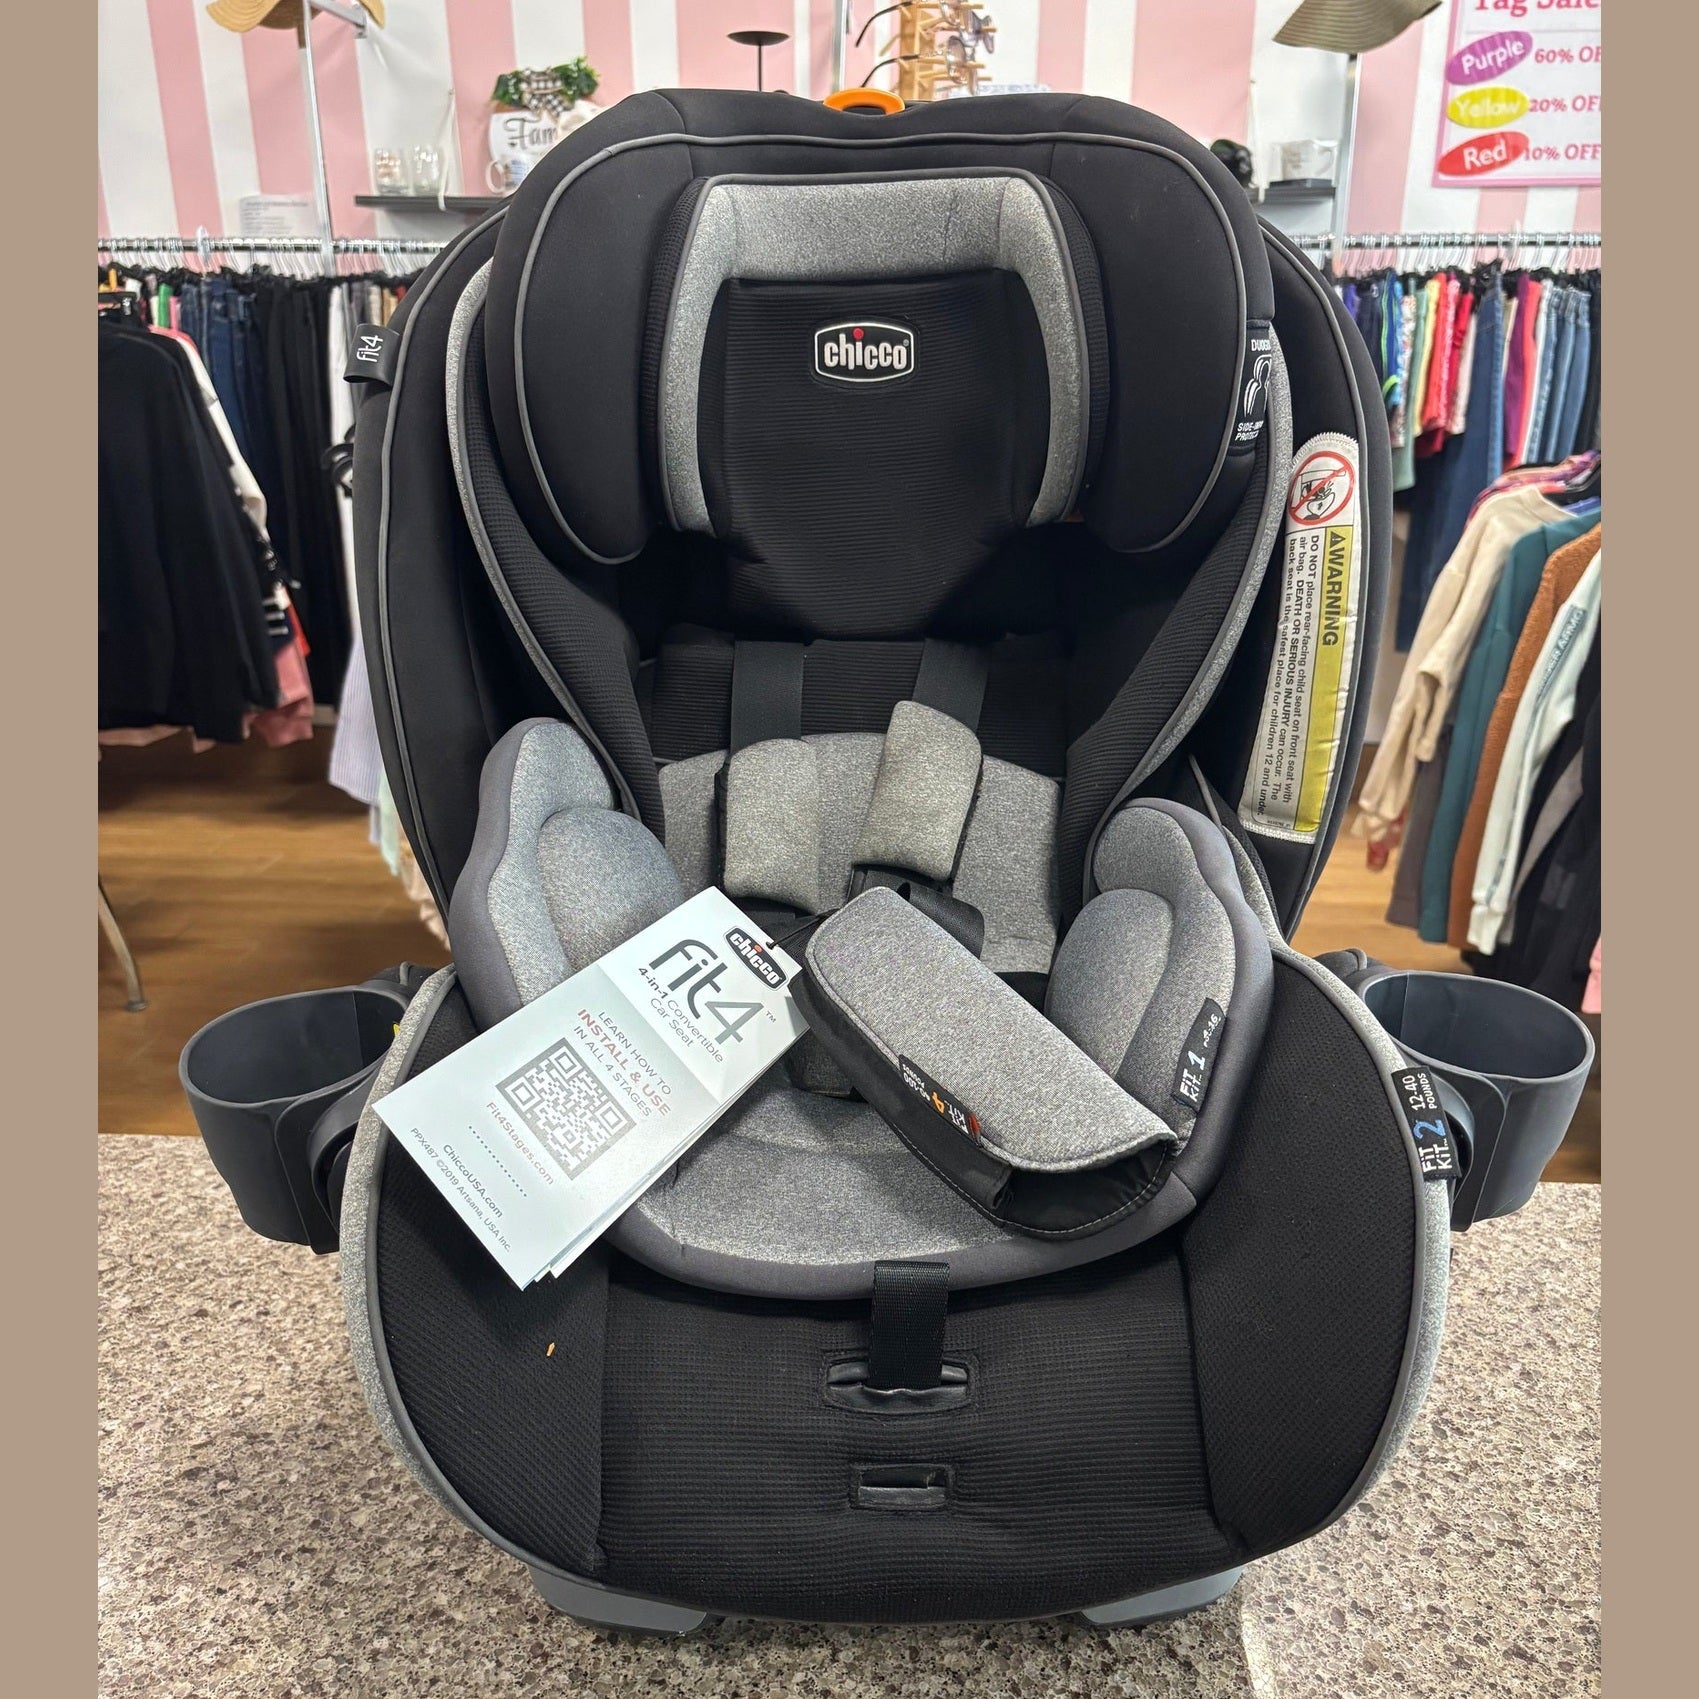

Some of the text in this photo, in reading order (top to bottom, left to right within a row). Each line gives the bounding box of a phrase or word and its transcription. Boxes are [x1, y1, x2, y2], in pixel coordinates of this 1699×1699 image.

[1461, 39, 1525, 75] Purple
[1535, 48, 1574, 64] 60%
[1456, 98, 1521, 118] Yellow
[1529, 95, 1601, 113] 20% OF
[1463, 138, 1507, 170] Red
[1524, 143, 1601, 161] 10% OFF
[356, 335, 384, 363] fit4
[824, 328, 907, 370] chicco
[1289, 538, 1297, 565] back
[1296, 552, 1307, 575] bag.
[1294, 580, 1304, 616] DEATH
[1322, 547, 1345, 646] WARNING
[1279, 625, 1289, 657] safest
[1292, 619, 1301, 635] OR
[1274, 660, 1285, 688] place
[1283, 535, 1319, 803] DO NOT place rear-facing child seat on front seat with
[1285, 637, 1299, 685] SERIOUS
[1273, 692, 1281, 706] for
[1281, 688, 1293, 727] INJURY
[1266, 709, 1279, 750] children
[1278, 728, 1286, 746] can
[1264, 753, 1273, 765] 12
[1274, 748, 1284, 777] occur.
[1261, 767, 1270, 787] and
[1271, 783, 1282, 800] The
[1257, 789, 1267, 816] under.
[729, 932, 782, 985] chicco
[649, 939, 764, 1045] fit4
[638, 967, 724, 1063] 4-in-1 Convertible
[650, 997, 696, 1047] Car Seat
[577, 1008, 672, 1116] INSTALL & USE
[598, 1011, 672, 1095] LEARN HOW TO
[1187, 1050, 1206, 1071] 1
[573, 1026, 652, 1117] IN ALL 4 STAGES
[932, 1091, 945, 1114] 4
[1402, 1075, 1426, 1111] 12-40
[1417, 1072, 1438, 1110] POUNDS
[486, 1102, 554, 1185] Fit4Stages.com
[1413, 1119, 1446, 1139] 2
[411, 1127, 439, 1159] PPX487
[456, 1186, 484, 1219] Artsana,
[483, 1217, 500, 1238] USA
[499, 1236, 511, 1253] Inc.
[443, 1144, 503, 1218] ChiccoUSA.com
